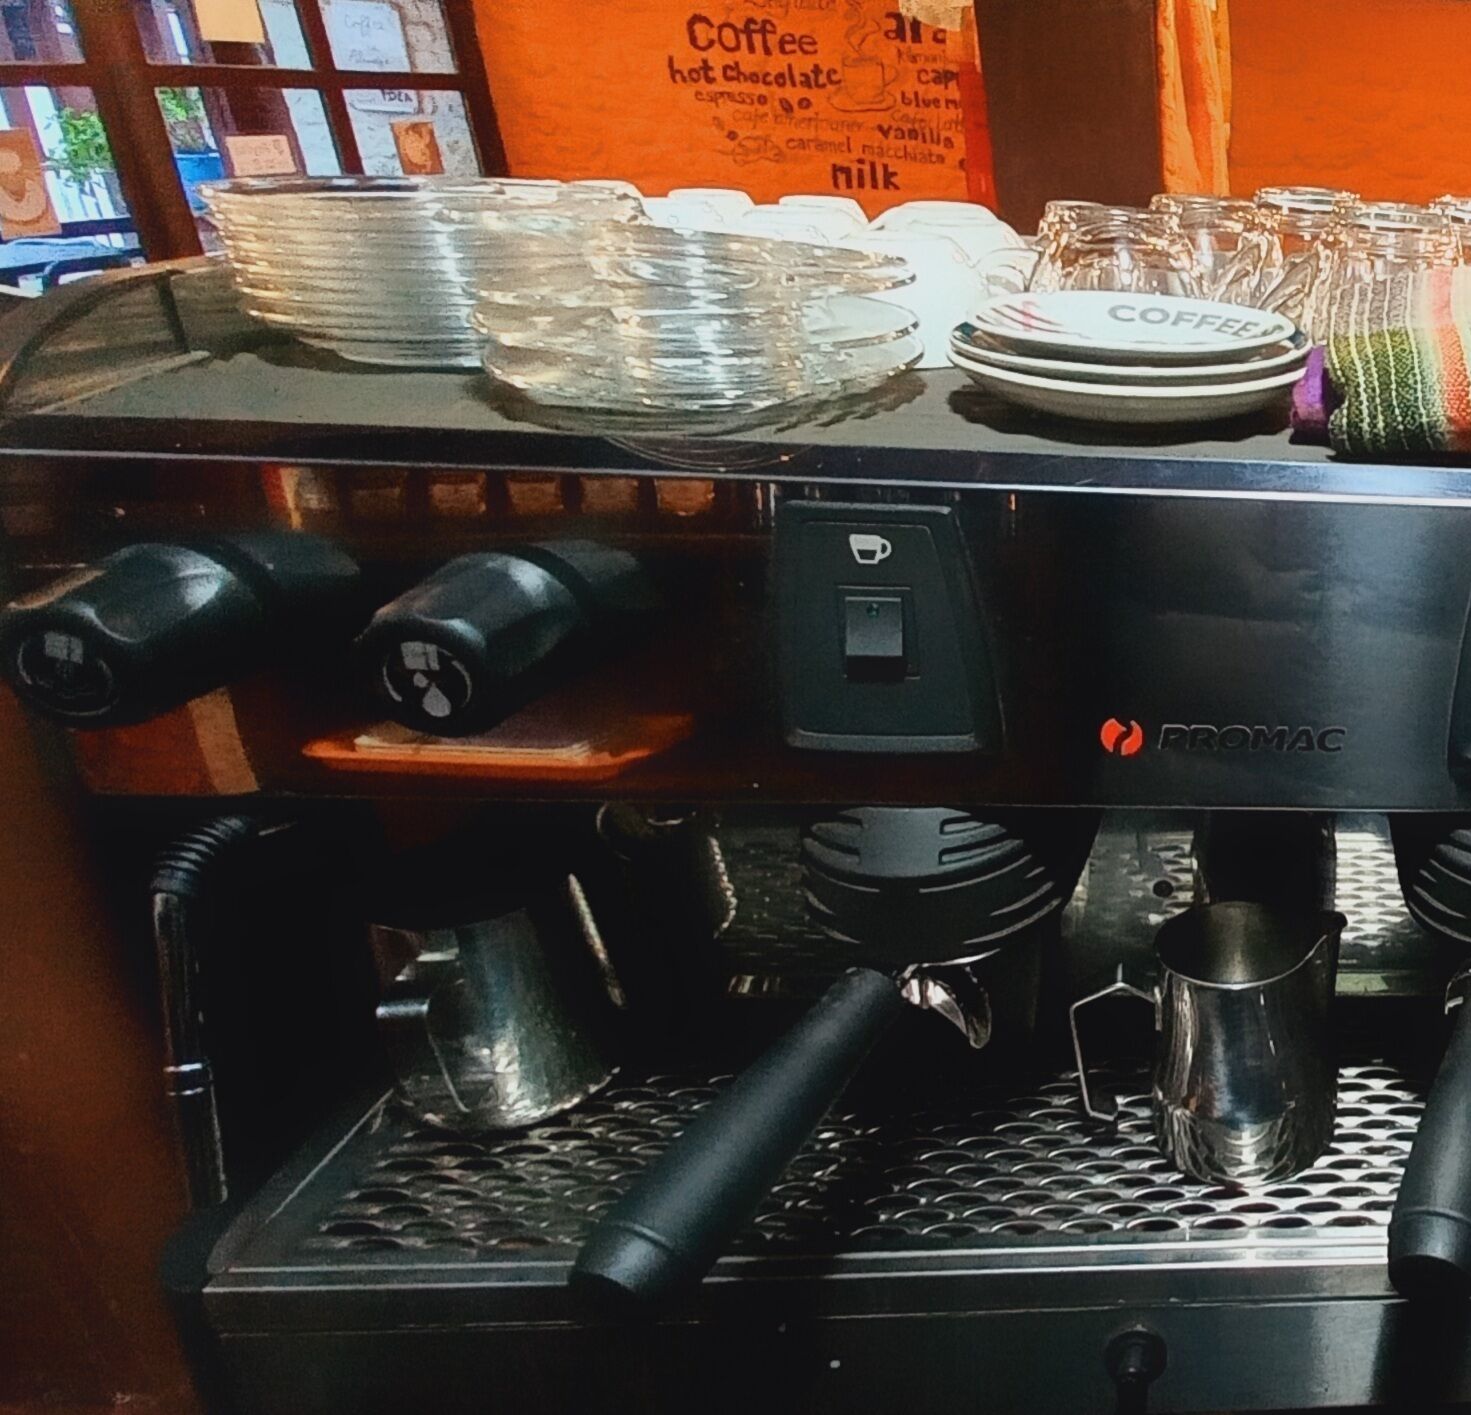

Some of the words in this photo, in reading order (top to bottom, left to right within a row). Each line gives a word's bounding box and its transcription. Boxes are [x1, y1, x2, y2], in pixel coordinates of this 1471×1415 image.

[686, 14, 819, 56] Coffee
[667, 55, 717, 85] hot
[901, 90, 941, 108] blue
[786, 136, 852, 154] caramel
[876, 123, 954, 149] vanilla
[832, 158, 900, 191] milk
[1107, 304, 1260, 337] COFFEE
[1158, 722, 1348, 753] PROMAC
